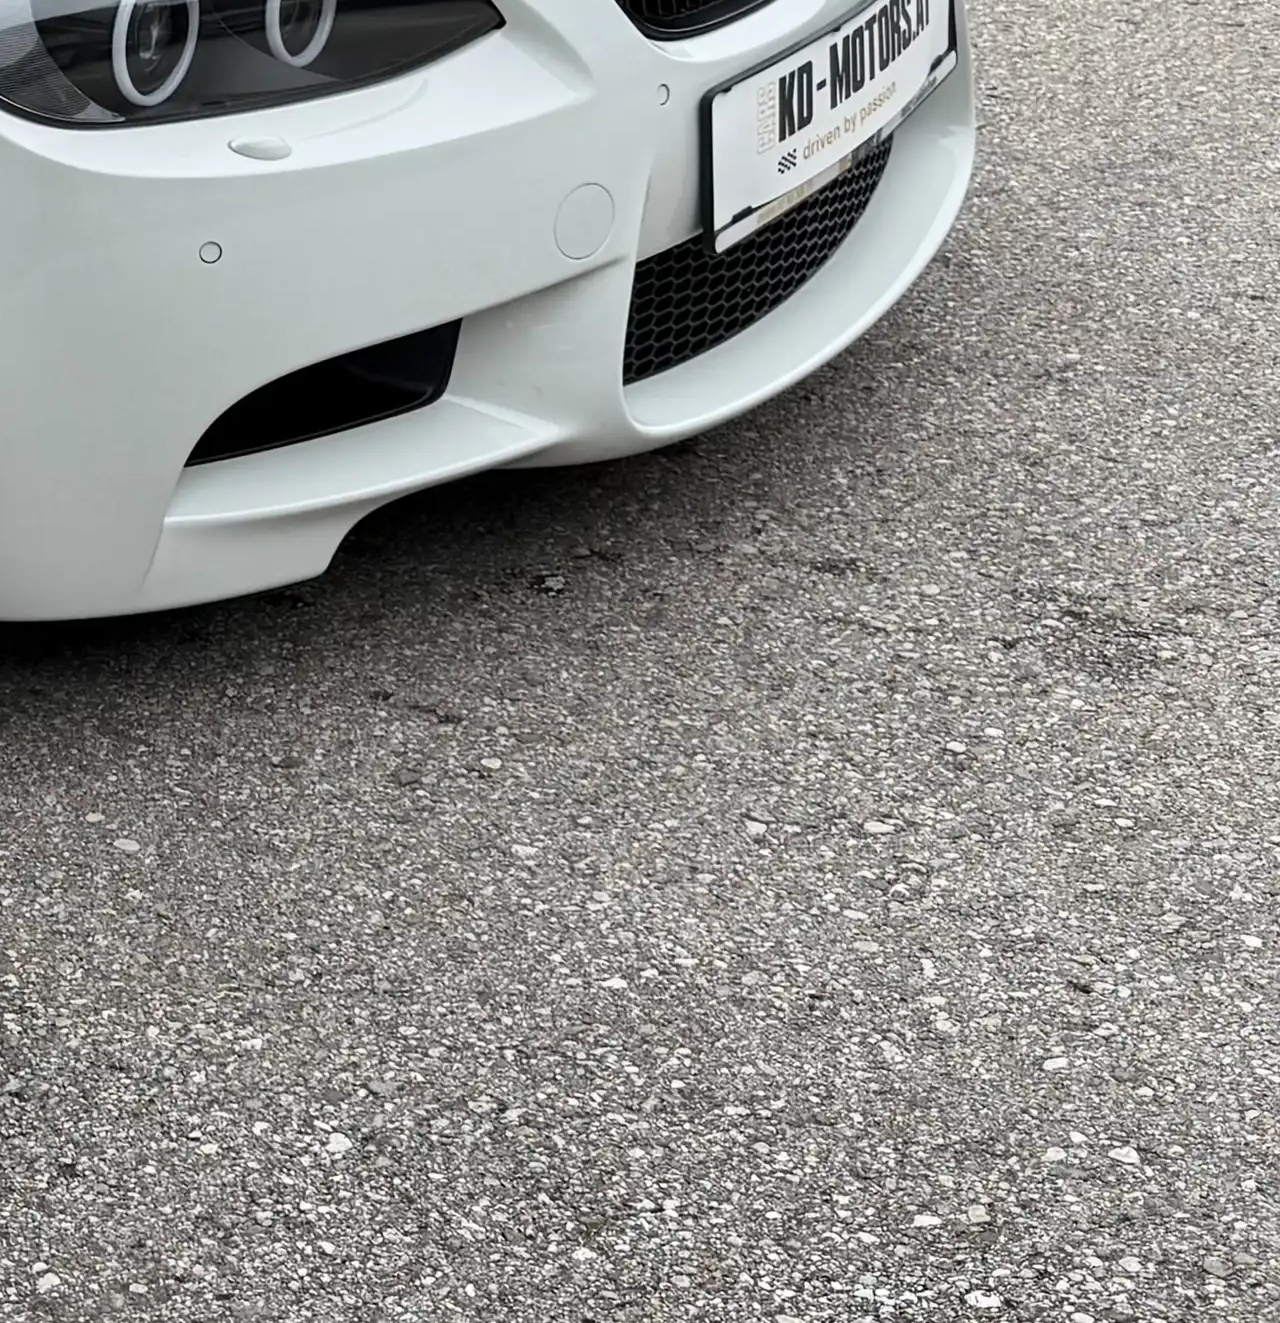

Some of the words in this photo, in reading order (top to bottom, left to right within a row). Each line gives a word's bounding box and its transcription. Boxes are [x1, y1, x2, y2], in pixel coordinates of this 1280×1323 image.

[802, 125, 841, 160] driven
[843, 110, 857, 134] by
[859, 81, 897, 122] passion
